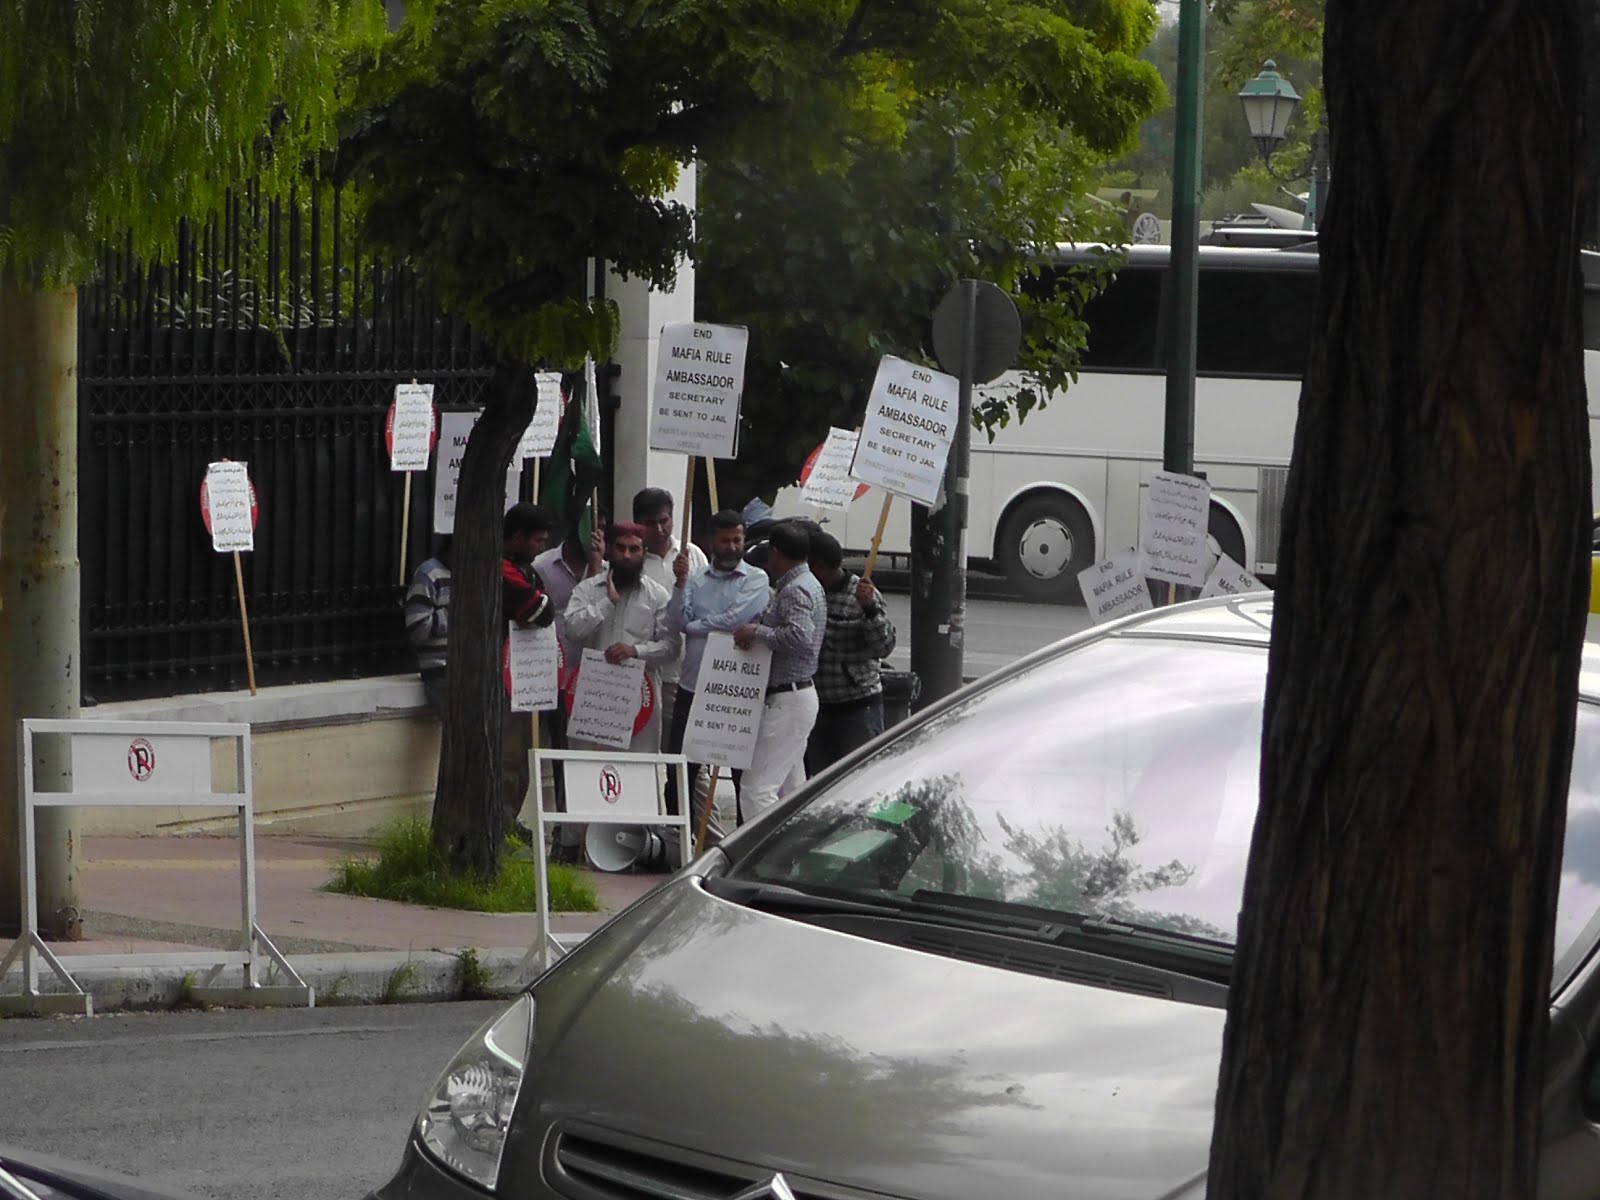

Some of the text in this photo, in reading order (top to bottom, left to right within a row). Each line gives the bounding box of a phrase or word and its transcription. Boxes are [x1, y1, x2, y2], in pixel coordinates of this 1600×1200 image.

[693, 328, 713, 339] END
[671, 346, 732, 365] MAFIA RULE
[666, 370, 734, 389] AMBASSADOR
[911, 370, 933, 384] END
[668, 391, 725, 405] SECRETARY
[886, 382, 949, 413] MAFIA RULE
[659, 408, 727, 424] BE SENT TO JAIL
[877, 405, 947, 437] AMBASSADOR
[879, 426, 937, 451] SECRETARY
[867, 440, 936, 469] BE SENT TO JAIL
[1093, 568, 1134, 597] MAFIA RULE
[1238, 574, 1252, 588] END
[1098, 585, 1143, 615] AMBASSADOR
[712, 658, 761, 676] MAFIA RULE
[704, 682, 760, 700] AMBASSADOR
[705, 703, 752, 717] SECRETARY
[694, 720, 752, 735] BE SENT TO JAIL
